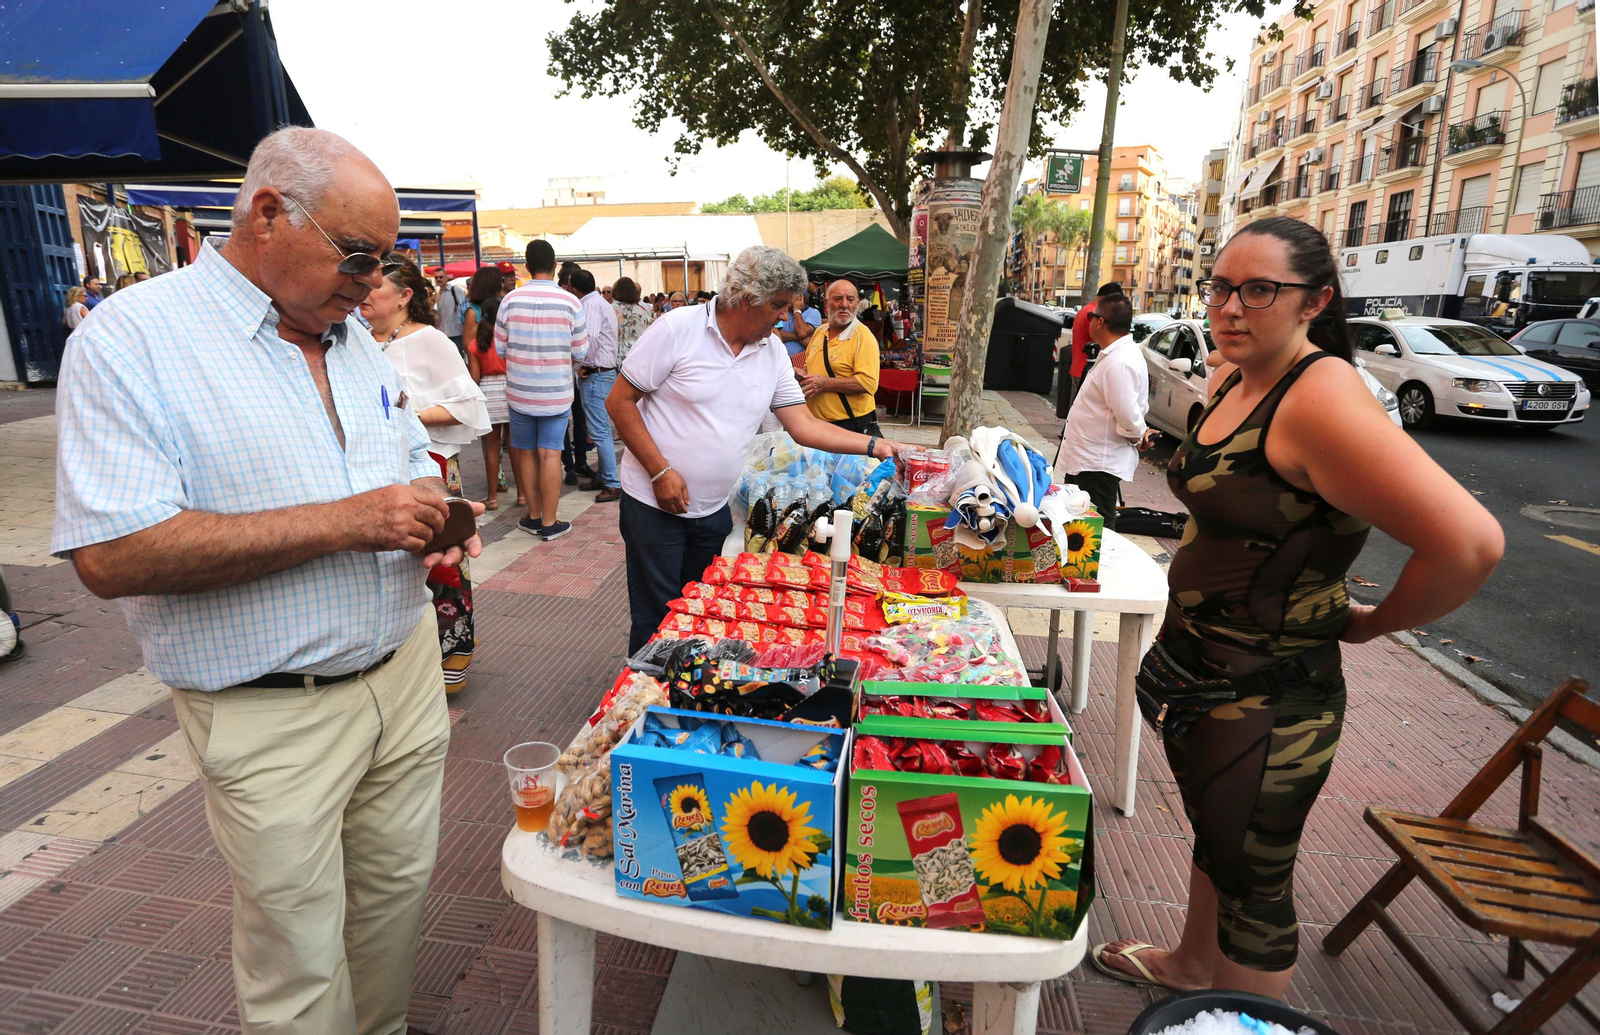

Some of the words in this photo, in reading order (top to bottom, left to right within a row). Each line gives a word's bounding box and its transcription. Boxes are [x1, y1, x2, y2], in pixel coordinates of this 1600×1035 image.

[1365, 296, 1403, 307] POLICÍA
[1363, 307, 1413, 316] NACL
[1527, 401, 1549, 409] 4200
[1551, 401, 1568, 409] GSV
[910, 513, 918, 542] secos
[906, 545, 916, 568] utos
[1003, 549, 1014, 582] frutos
[923, 571, 940, 591] Reyes
[517, 789, 548, 797] Cruzcampo
[617, 763, 637, 840] Marina
[674, 813, 700, 829] Reyes
[859, 785, 877, 847] secos
[917, 818, 949, 835] Reyes
[619, 841, 640, 879] Sal
[651, 867, 677, 880] Pipas
[619, 880, 641, 891] con
[644, 878, 683, 894] Reyes
[849, 853, 873, 920] frutos
[879, 902, 924, 918] Reyes
